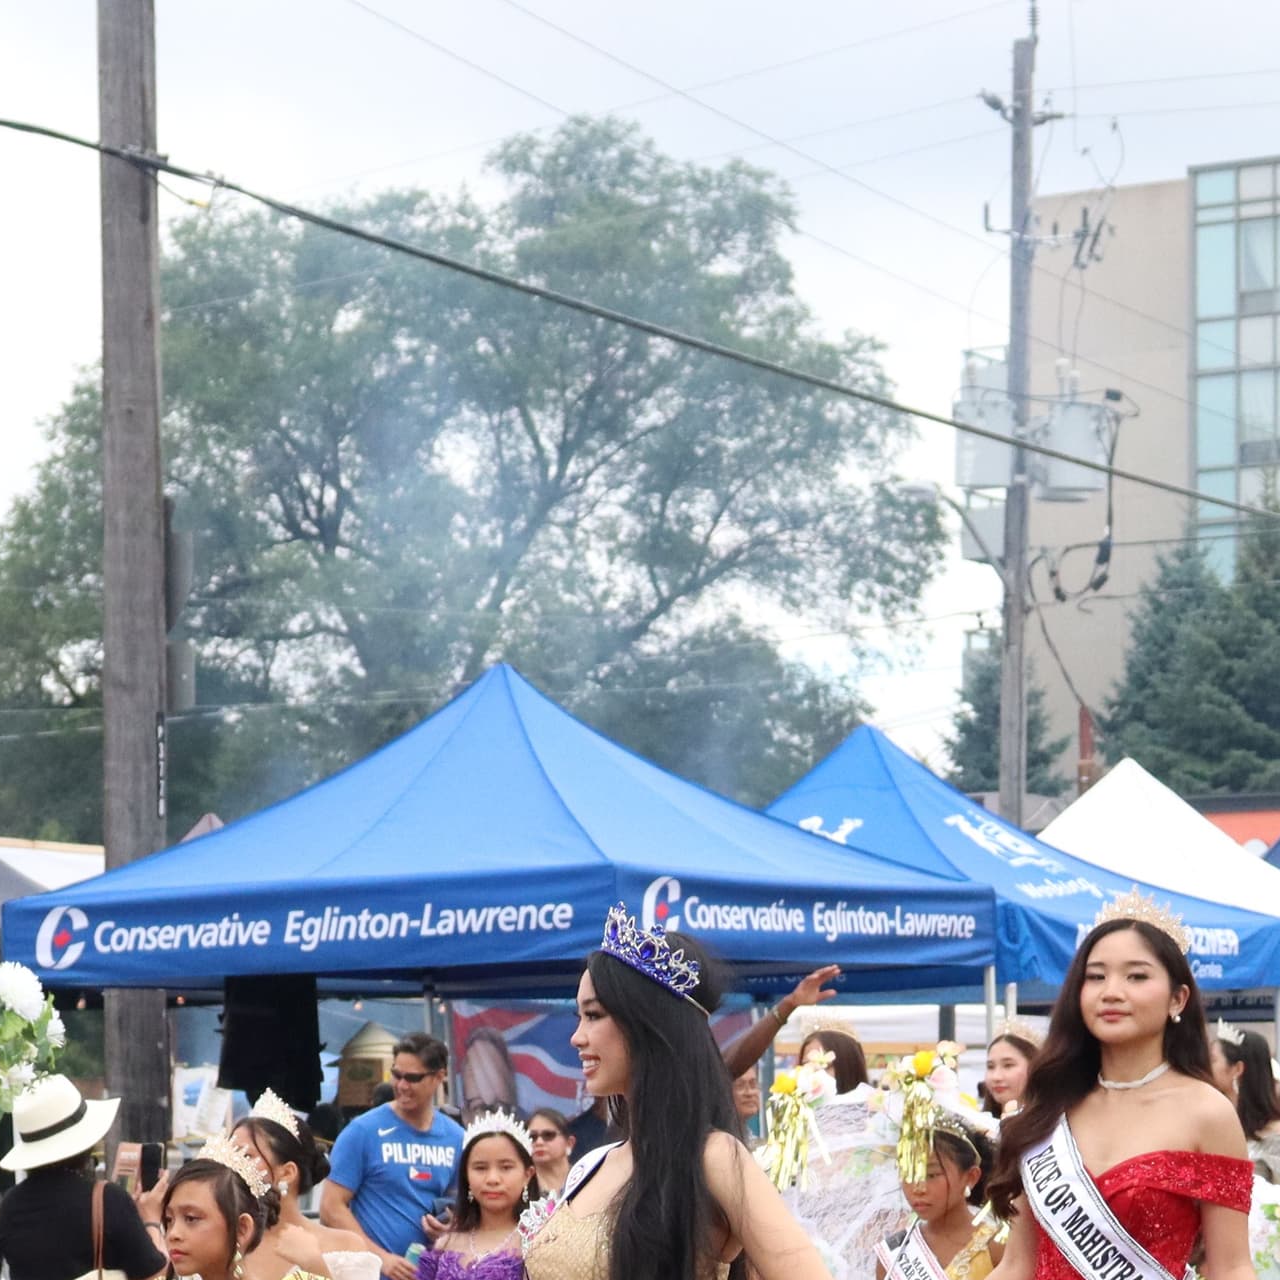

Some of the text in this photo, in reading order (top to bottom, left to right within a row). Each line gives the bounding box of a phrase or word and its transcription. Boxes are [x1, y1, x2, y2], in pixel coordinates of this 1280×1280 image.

[94, 911, 271, 953] Conservative
[284, 900, 574, 951] Eglinton-Lawrence
[683, 896, 805, 932] Conservative
[813, 900, 976, 943] Eglinton-Lawrence
[381, 1142, 455, 1168] PILIPINAS
[1026, 1144, 1062, 1193] FACE
[1043, 1183, 1076, 1215] OF
